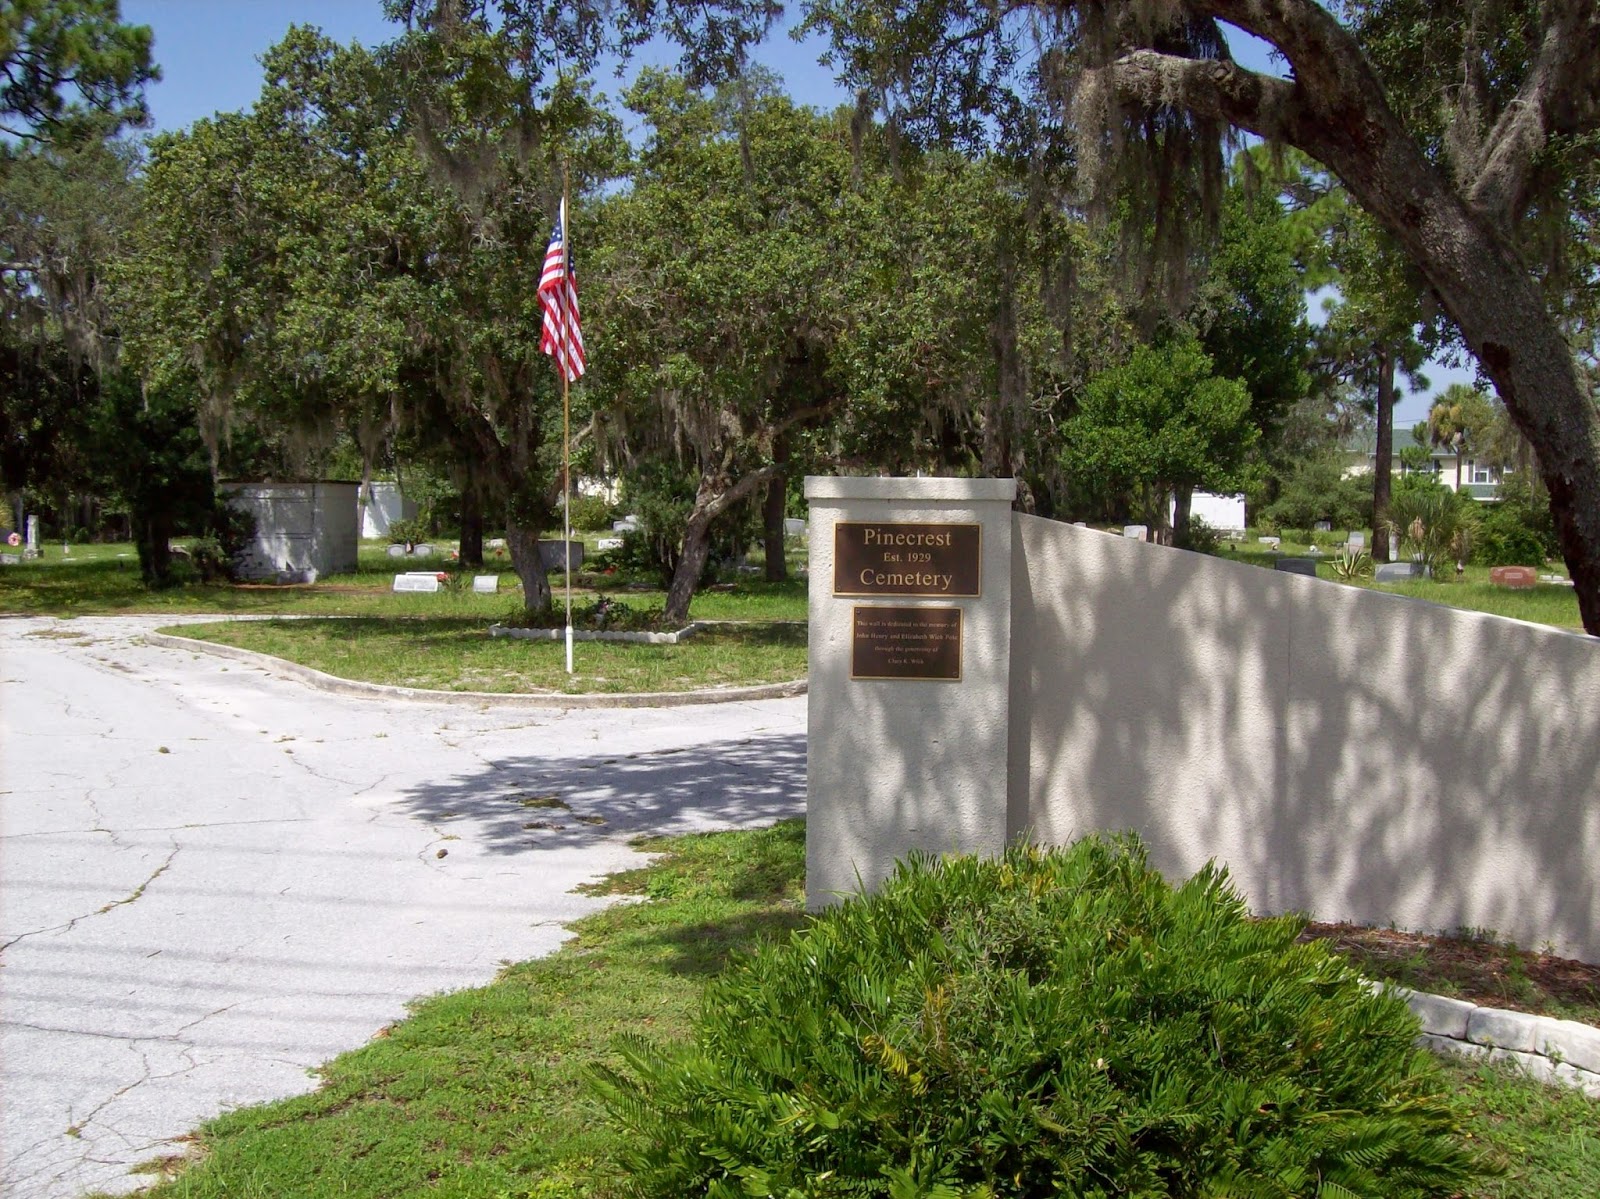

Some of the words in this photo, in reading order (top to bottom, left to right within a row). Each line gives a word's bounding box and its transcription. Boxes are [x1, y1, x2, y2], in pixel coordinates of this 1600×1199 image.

[863, 528, 952, 546] Pinecrest
[883, 552, 903, 562] Est.
[907, 552, 931, 563] 1929
[860, 568, 953, 591] Cemetery
